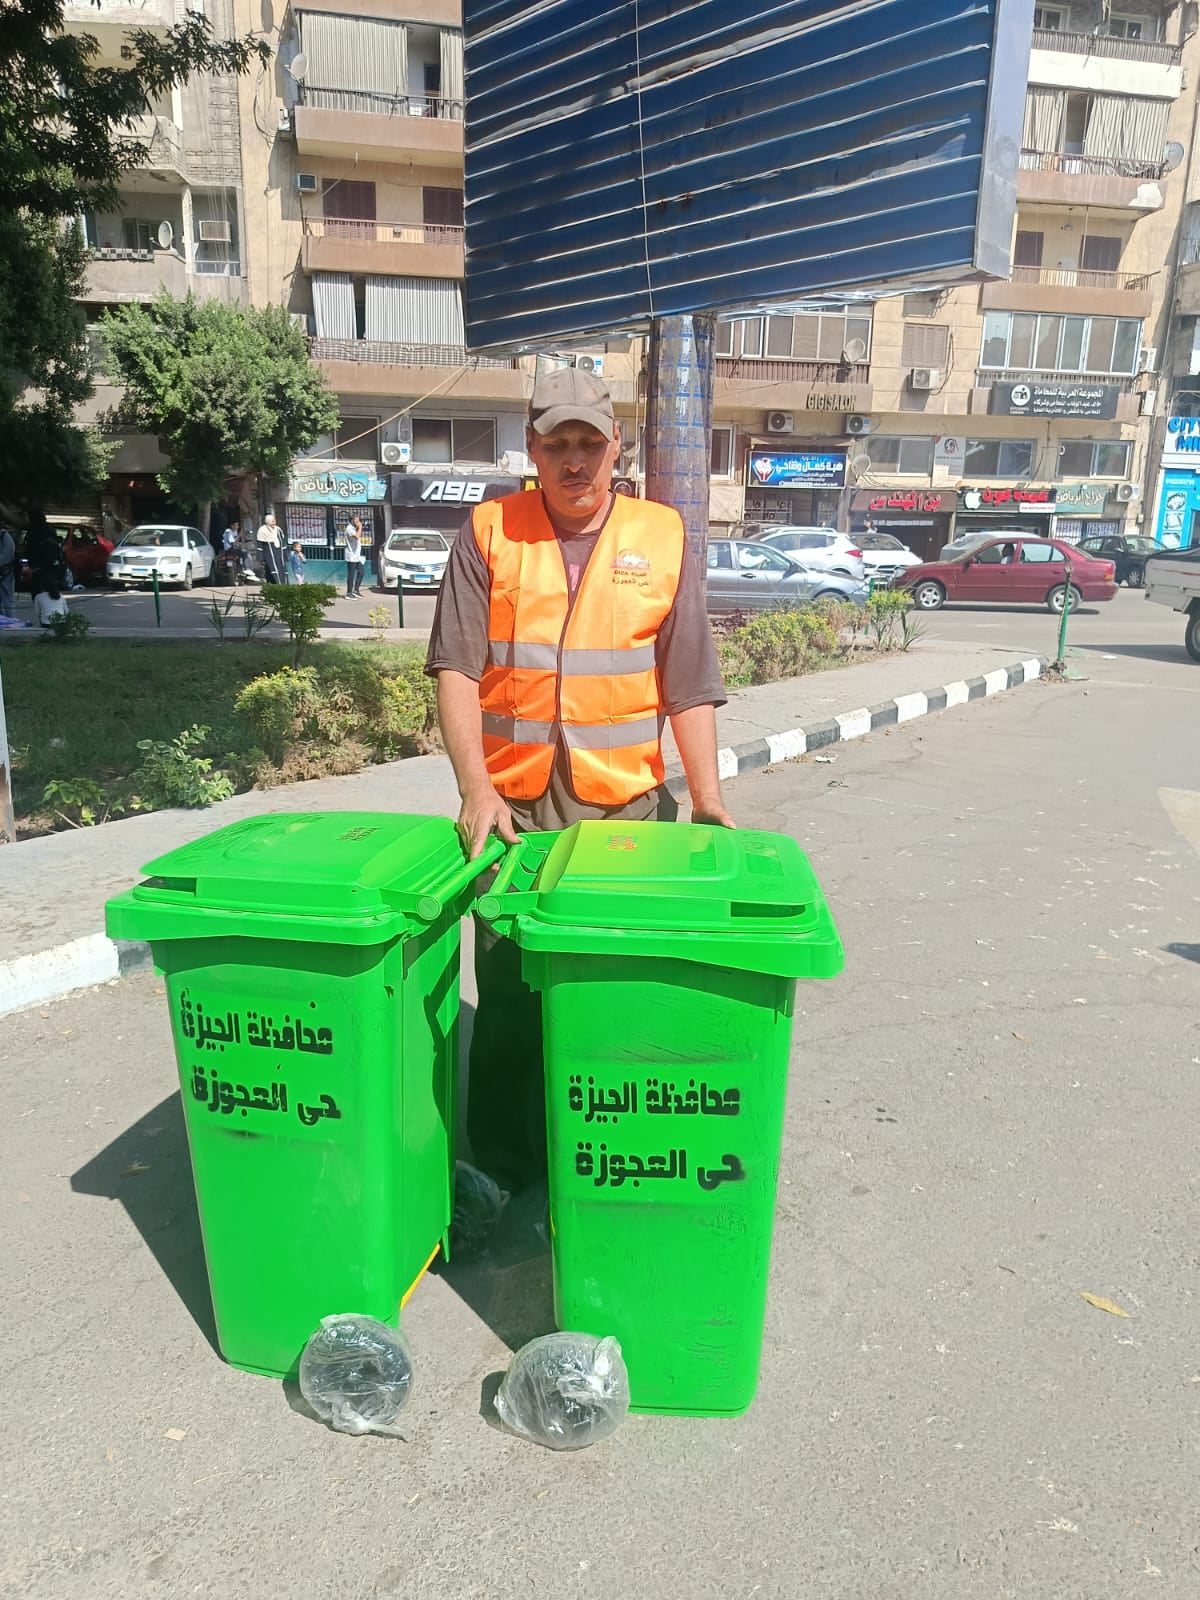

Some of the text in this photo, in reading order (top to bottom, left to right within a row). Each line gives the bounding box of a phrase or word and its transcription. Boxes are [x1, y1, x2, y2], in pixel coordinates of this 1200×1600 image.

[1168, 416, 1200, 433] CIT
[340, 478, 364, 497] جراج
[1085, 490, 1104, 506] جراج
[180, 990, 333, 1055] محافظة الجيزة
[192, 1065, 288, 1117] العجوزة
[568, 1075, 741, 1124] محافظة الجيزة
[575, 1141, 687, 1188] العجوزة
